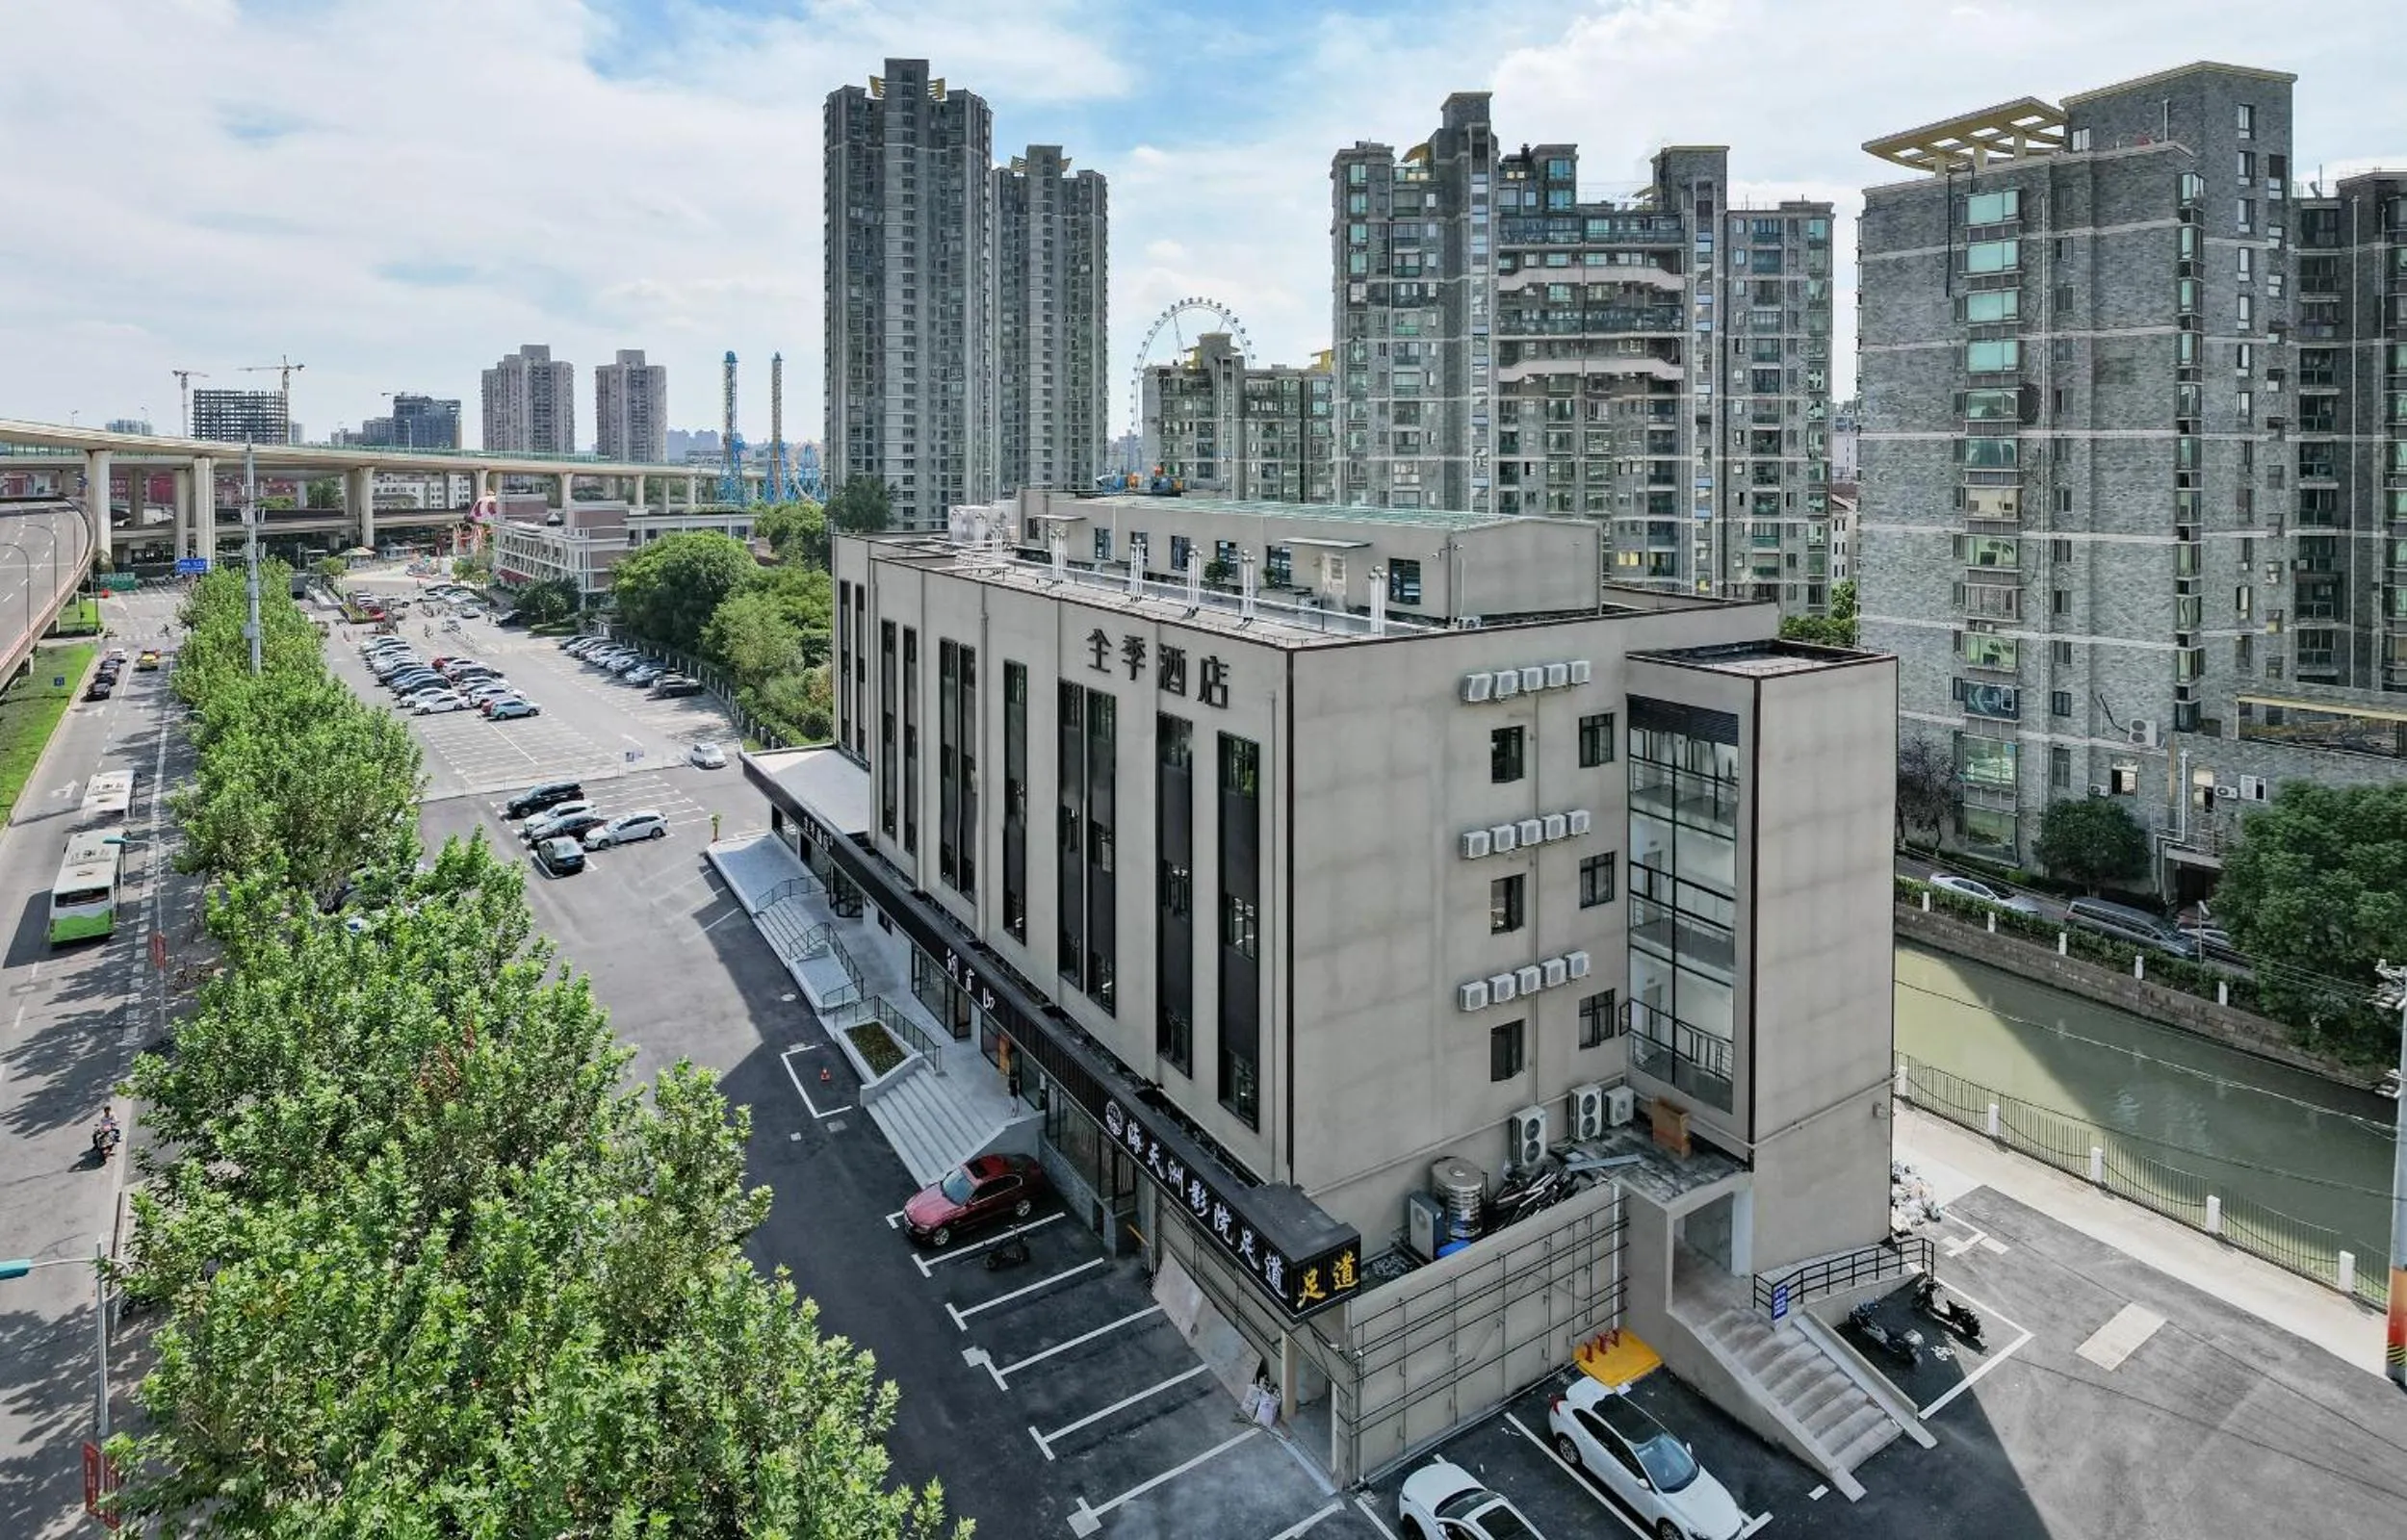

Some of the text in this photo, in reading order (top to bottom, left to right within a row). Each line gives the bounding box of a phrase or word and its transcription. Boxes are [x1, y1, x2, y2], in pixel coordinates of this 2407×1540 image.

[1085, 628, 1230, 709] 全季酒店
[1296, 1249, 1359, 1308] 足道
